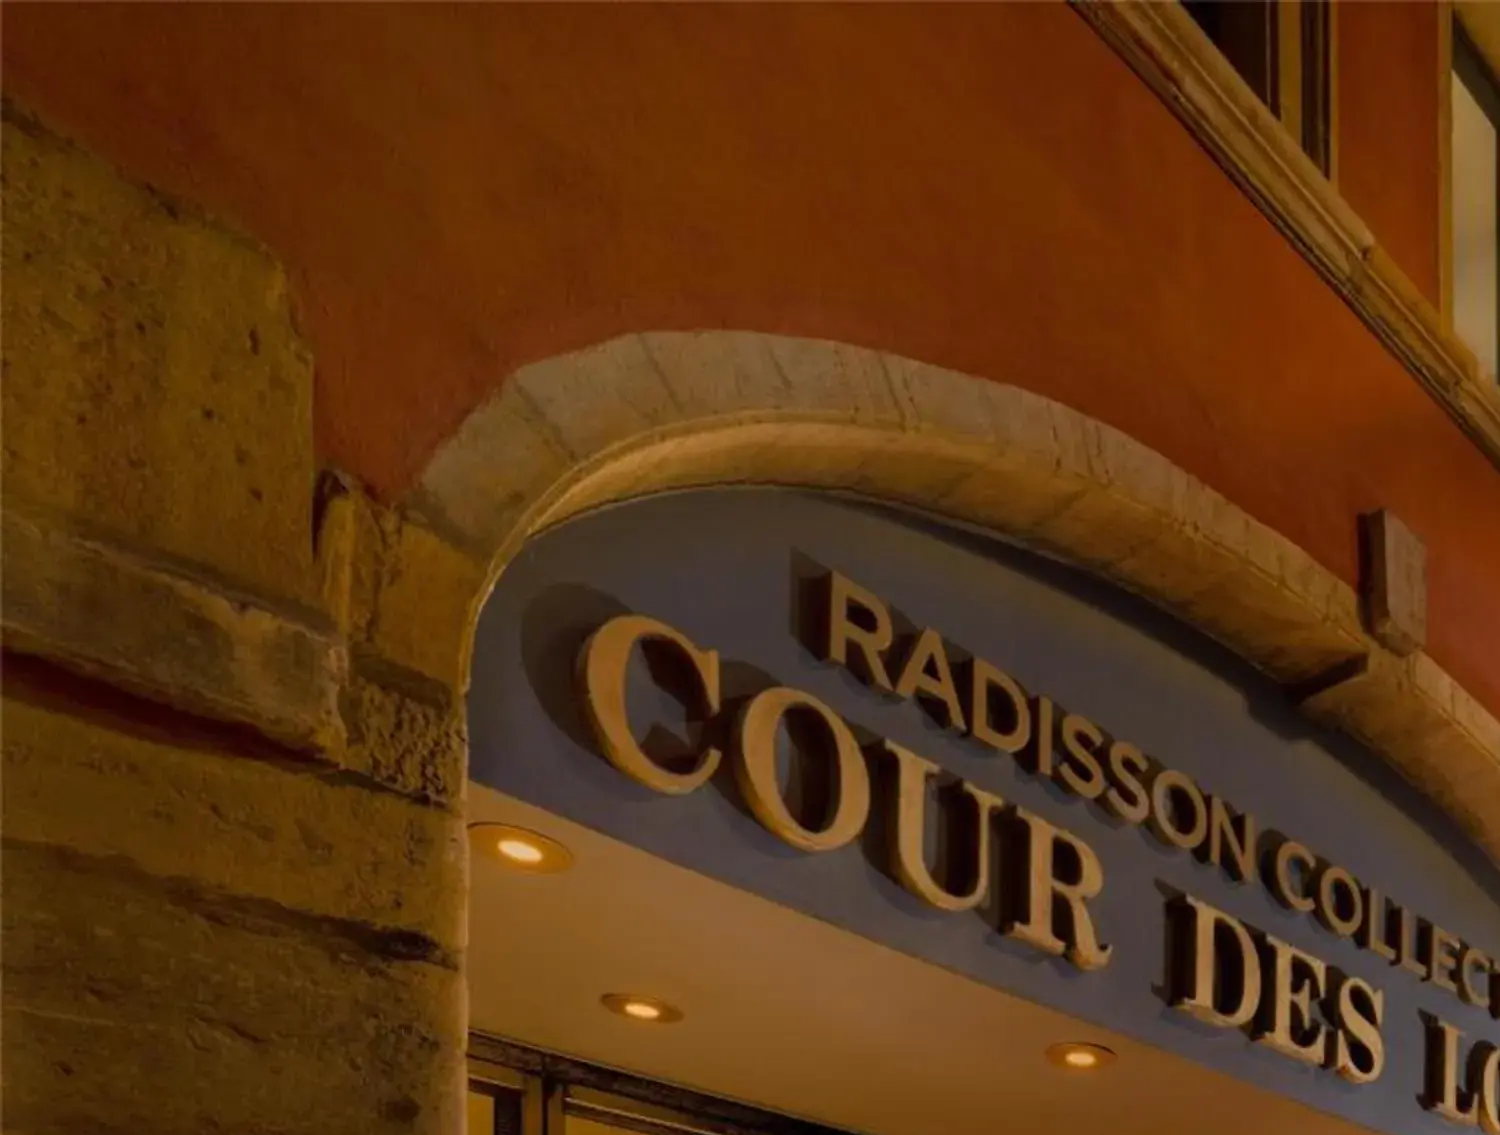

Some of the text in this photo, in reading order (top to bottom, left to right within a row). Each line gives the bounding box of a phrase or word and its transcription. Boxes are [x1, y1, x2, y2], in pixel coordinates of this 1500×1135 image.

[585, 614, 1113, 972] COUR
[1181, 894, 1385, 1085] DES
[828, 568, 1258, 885] RADISSON
